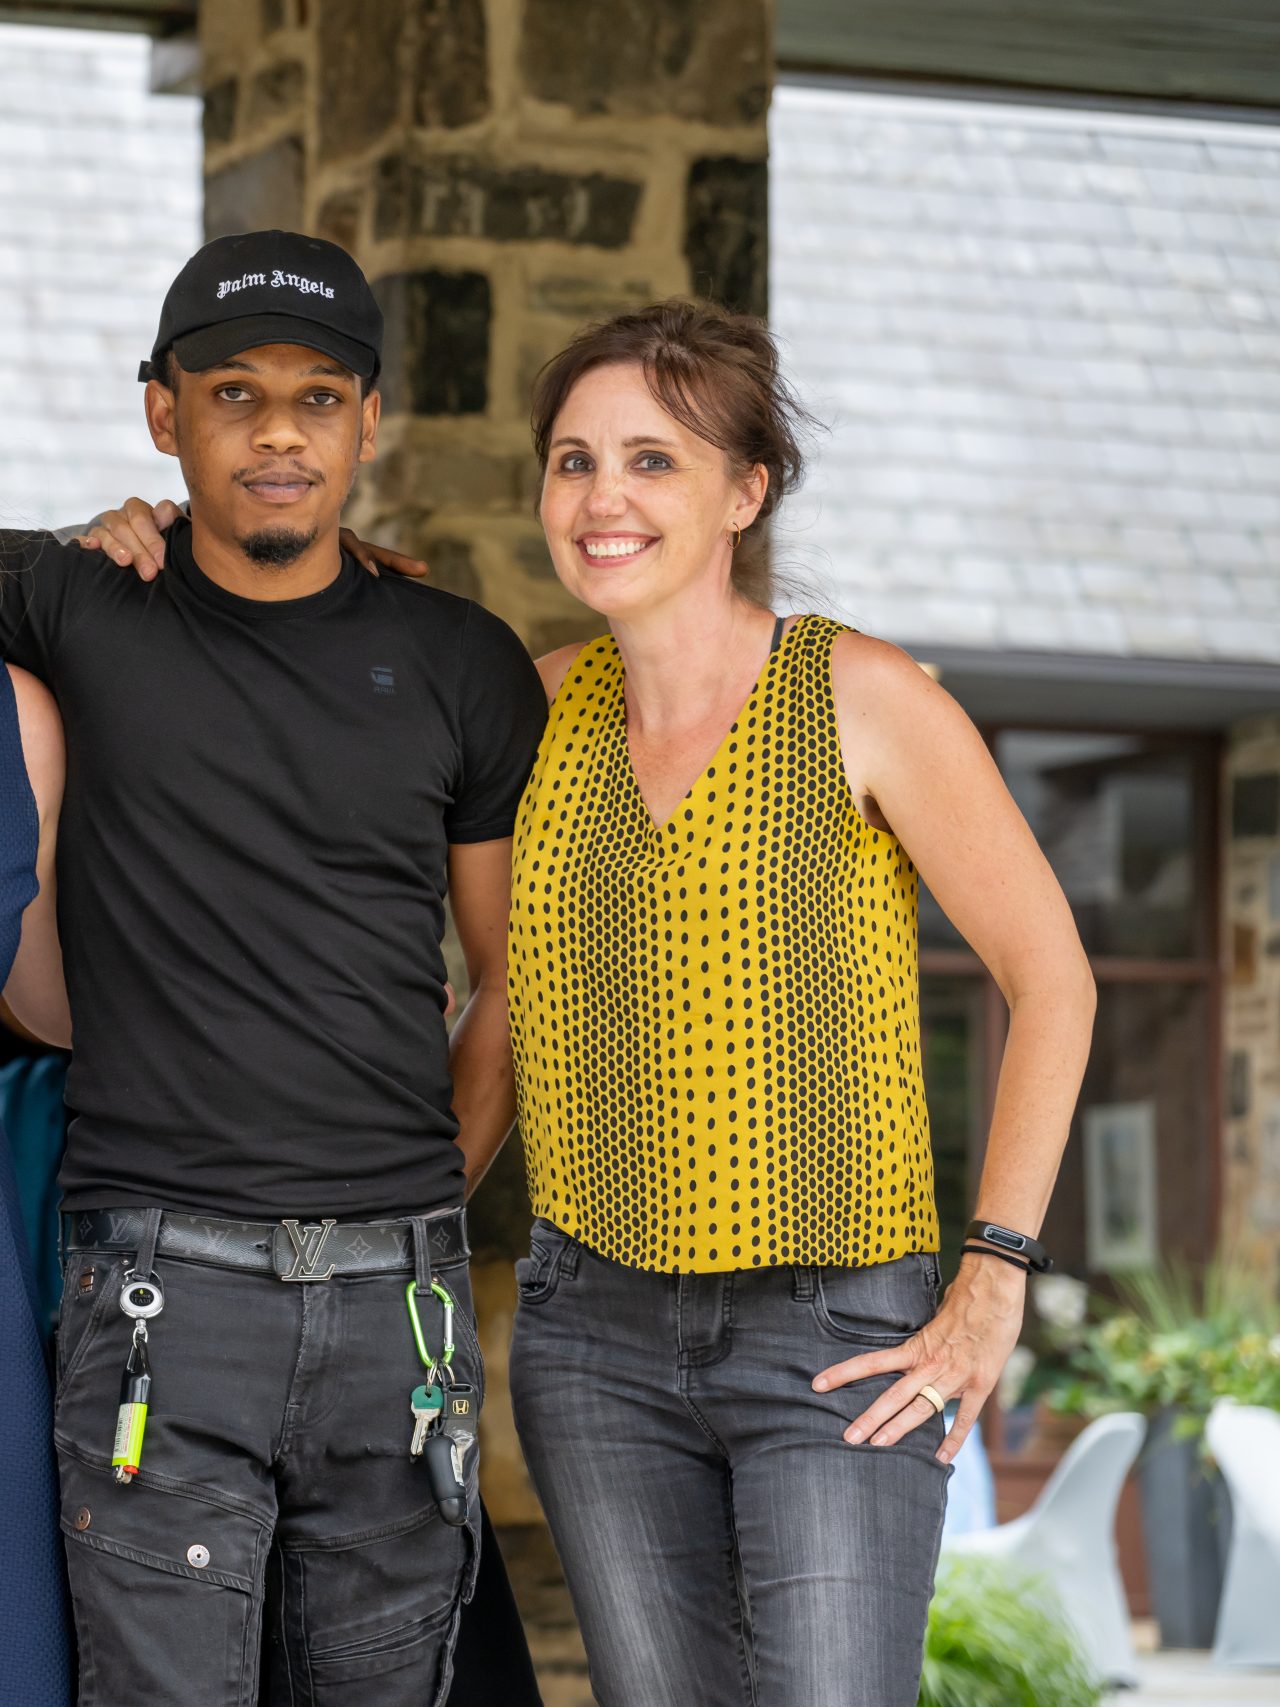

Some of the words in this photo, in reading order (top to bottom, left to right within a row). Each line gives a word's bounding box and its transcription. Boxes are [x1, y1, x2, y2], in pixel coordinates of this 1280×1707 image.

[217, 273, 266, 299] Palm
[270, 270, 334, 298] Angels
[282, 1220, 336, 1280] LV
